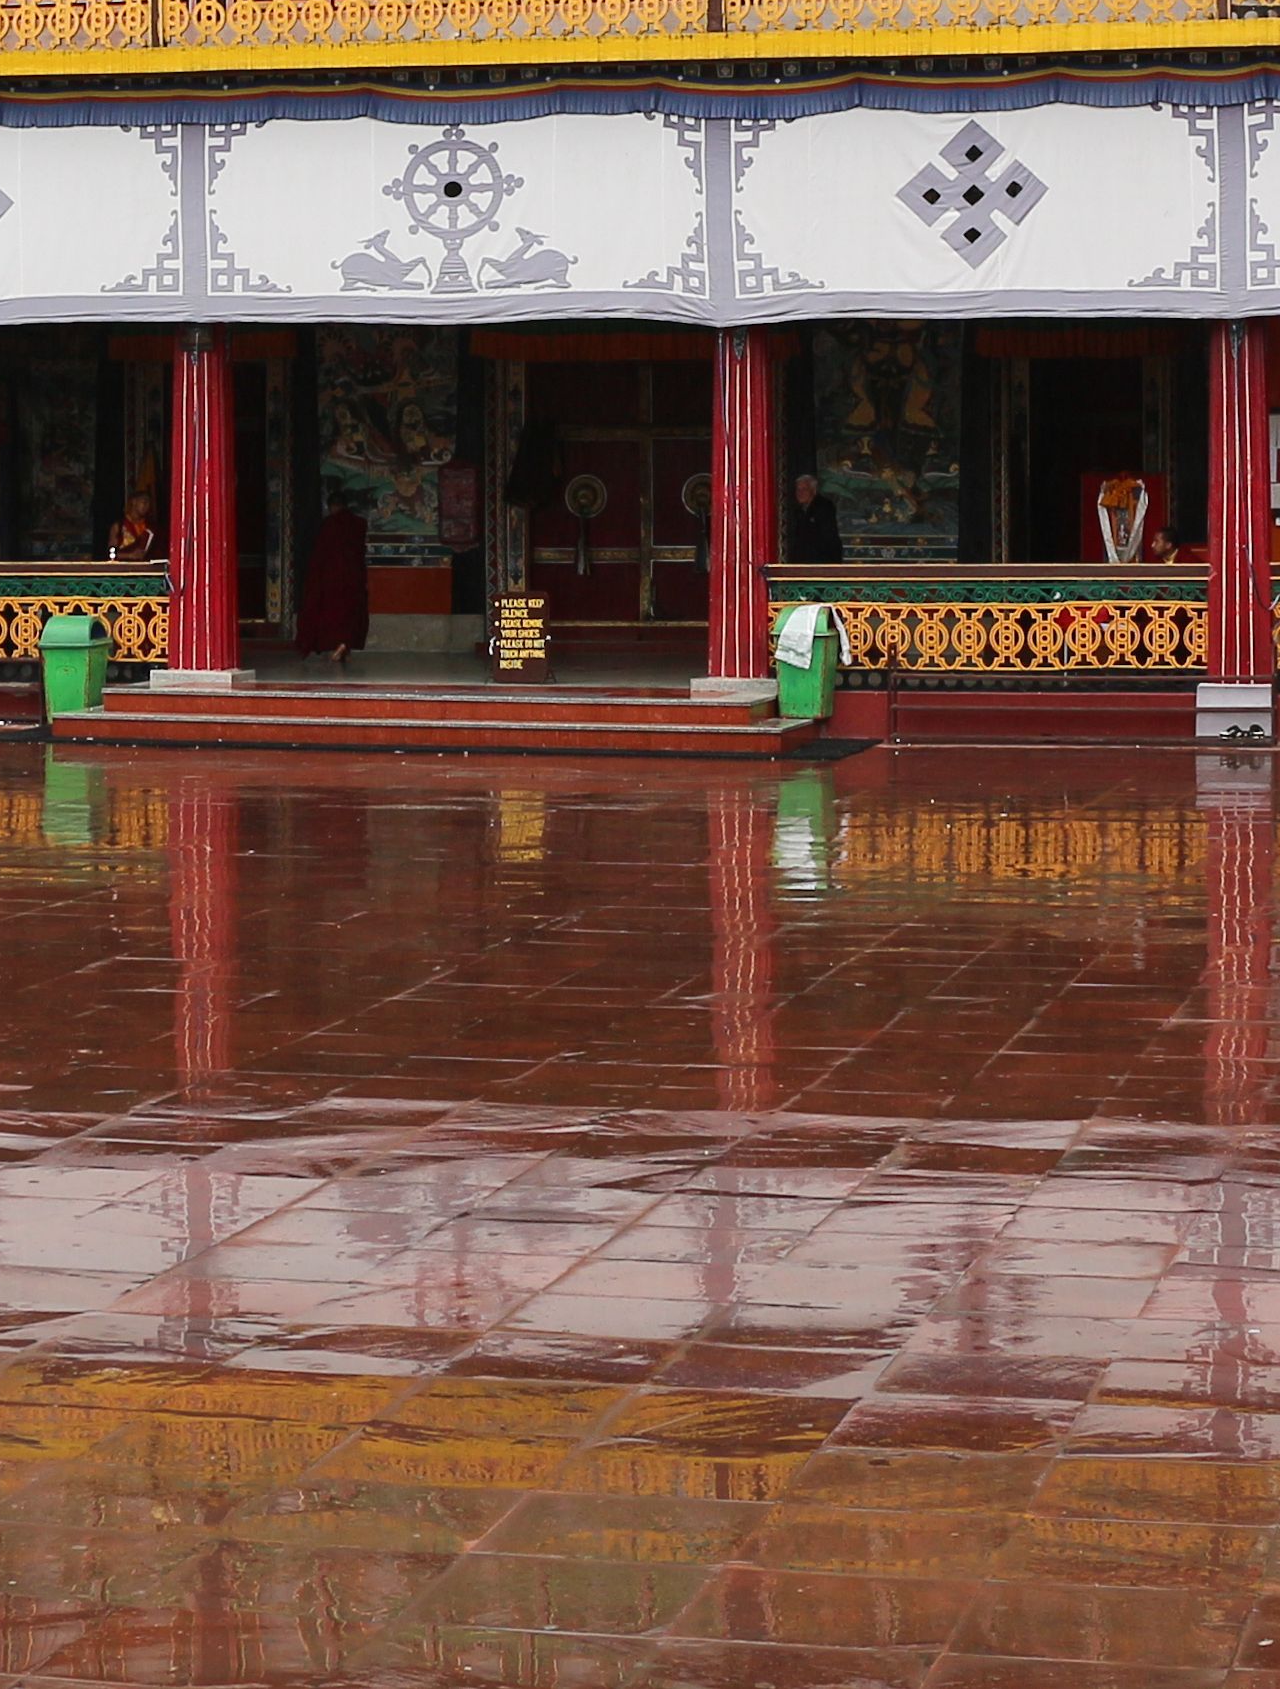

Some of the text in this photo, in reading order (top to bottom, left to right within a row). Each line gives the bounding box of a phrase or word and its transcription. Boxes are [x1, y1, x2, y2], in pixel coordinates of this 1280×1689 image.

[501, 598, 545, 608] PLEASE KEEP
[501, 608, 528, 618] SILENCE
[500, 618, 522, 629] PLEASE
[501, 629, 540, 638] YOUR SHOES
[501, 639, 545, 649] PLEASE DO NOT
[500, 649, 545, 659] TOUCH ANYTHING
[500, 659, 523, 670] INSIDE
